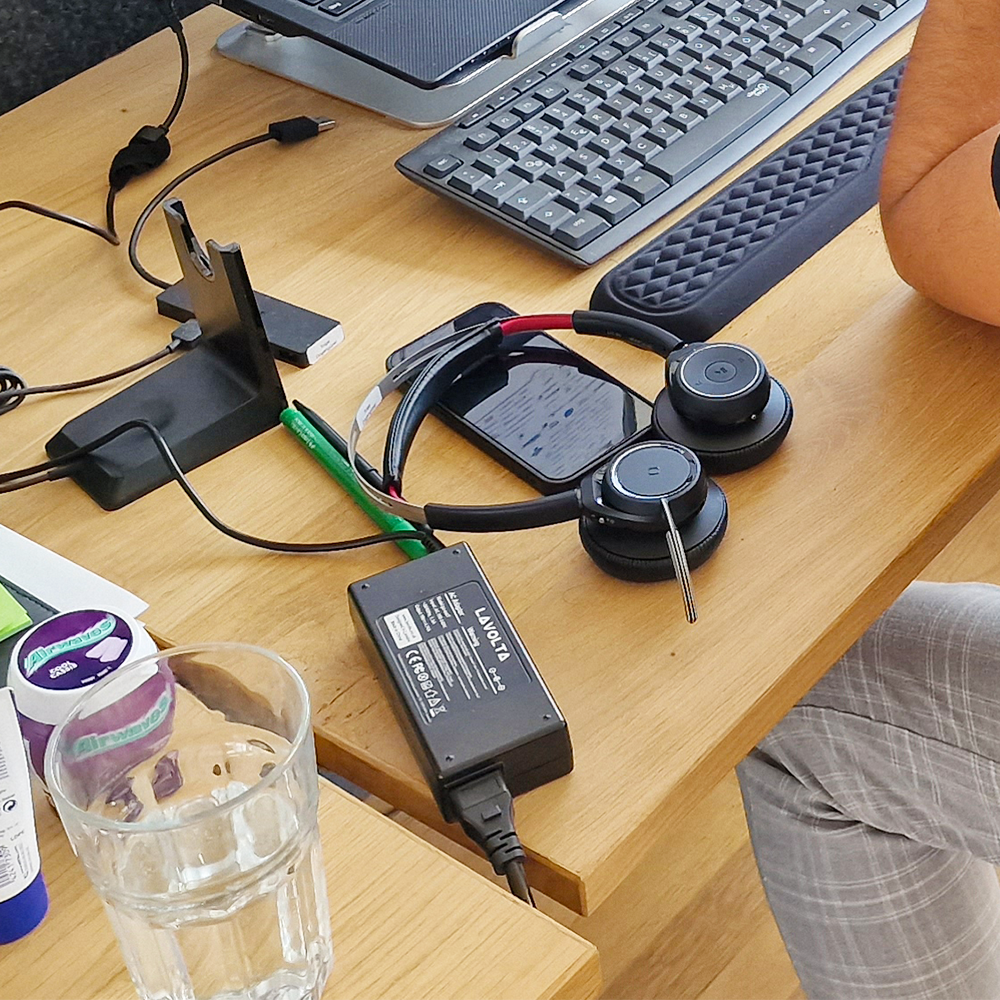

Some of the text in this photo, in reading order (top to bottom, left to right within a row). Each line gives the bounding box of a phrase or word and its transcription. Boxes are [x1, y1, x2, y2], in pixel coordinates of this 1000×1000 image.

[26, 617, 114, 670] Airwaves
[474, 606, 511, 662] LAVOLTA
[74, 695, 170, 756] Airwaves
